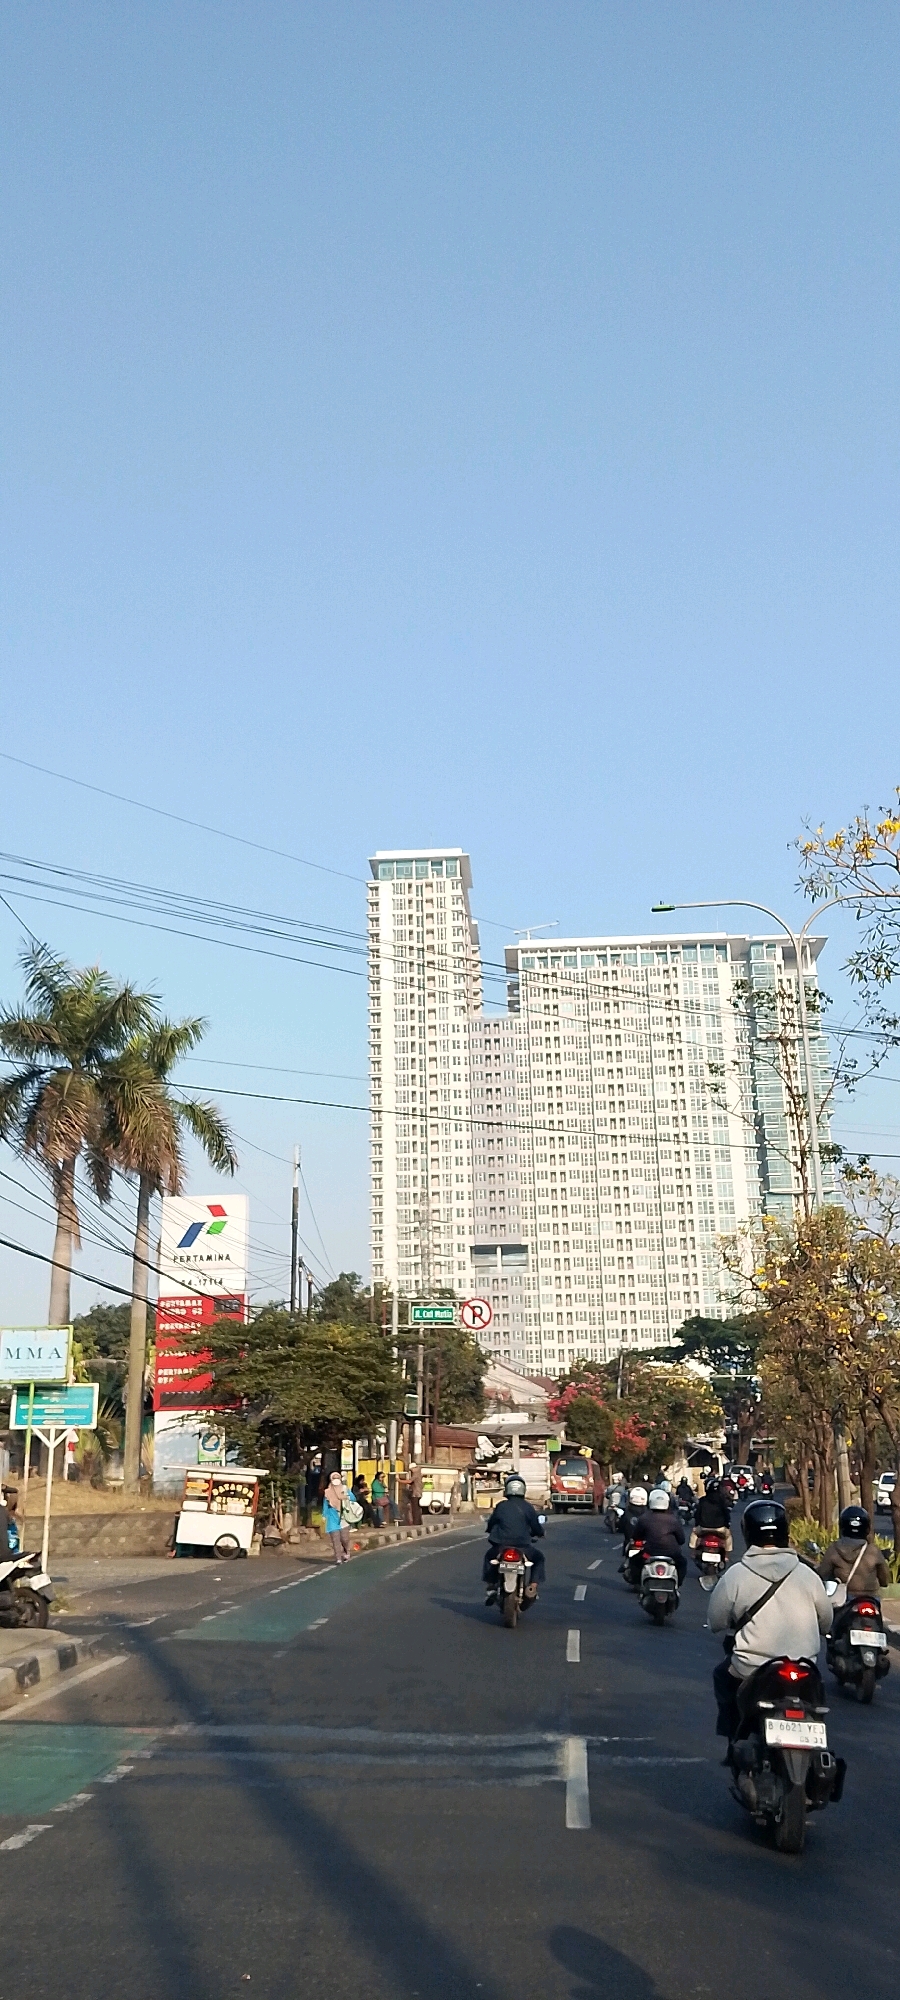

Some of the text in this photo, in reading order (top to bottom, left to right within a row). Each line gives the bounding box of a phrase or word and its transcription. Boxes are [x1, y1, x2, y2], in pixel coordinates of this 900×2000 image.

[173, 1254, 231, 1263] PERTAMINA
[768, 1720, 774, 1731] B
[780, 1722, 802, 1732] 6621
